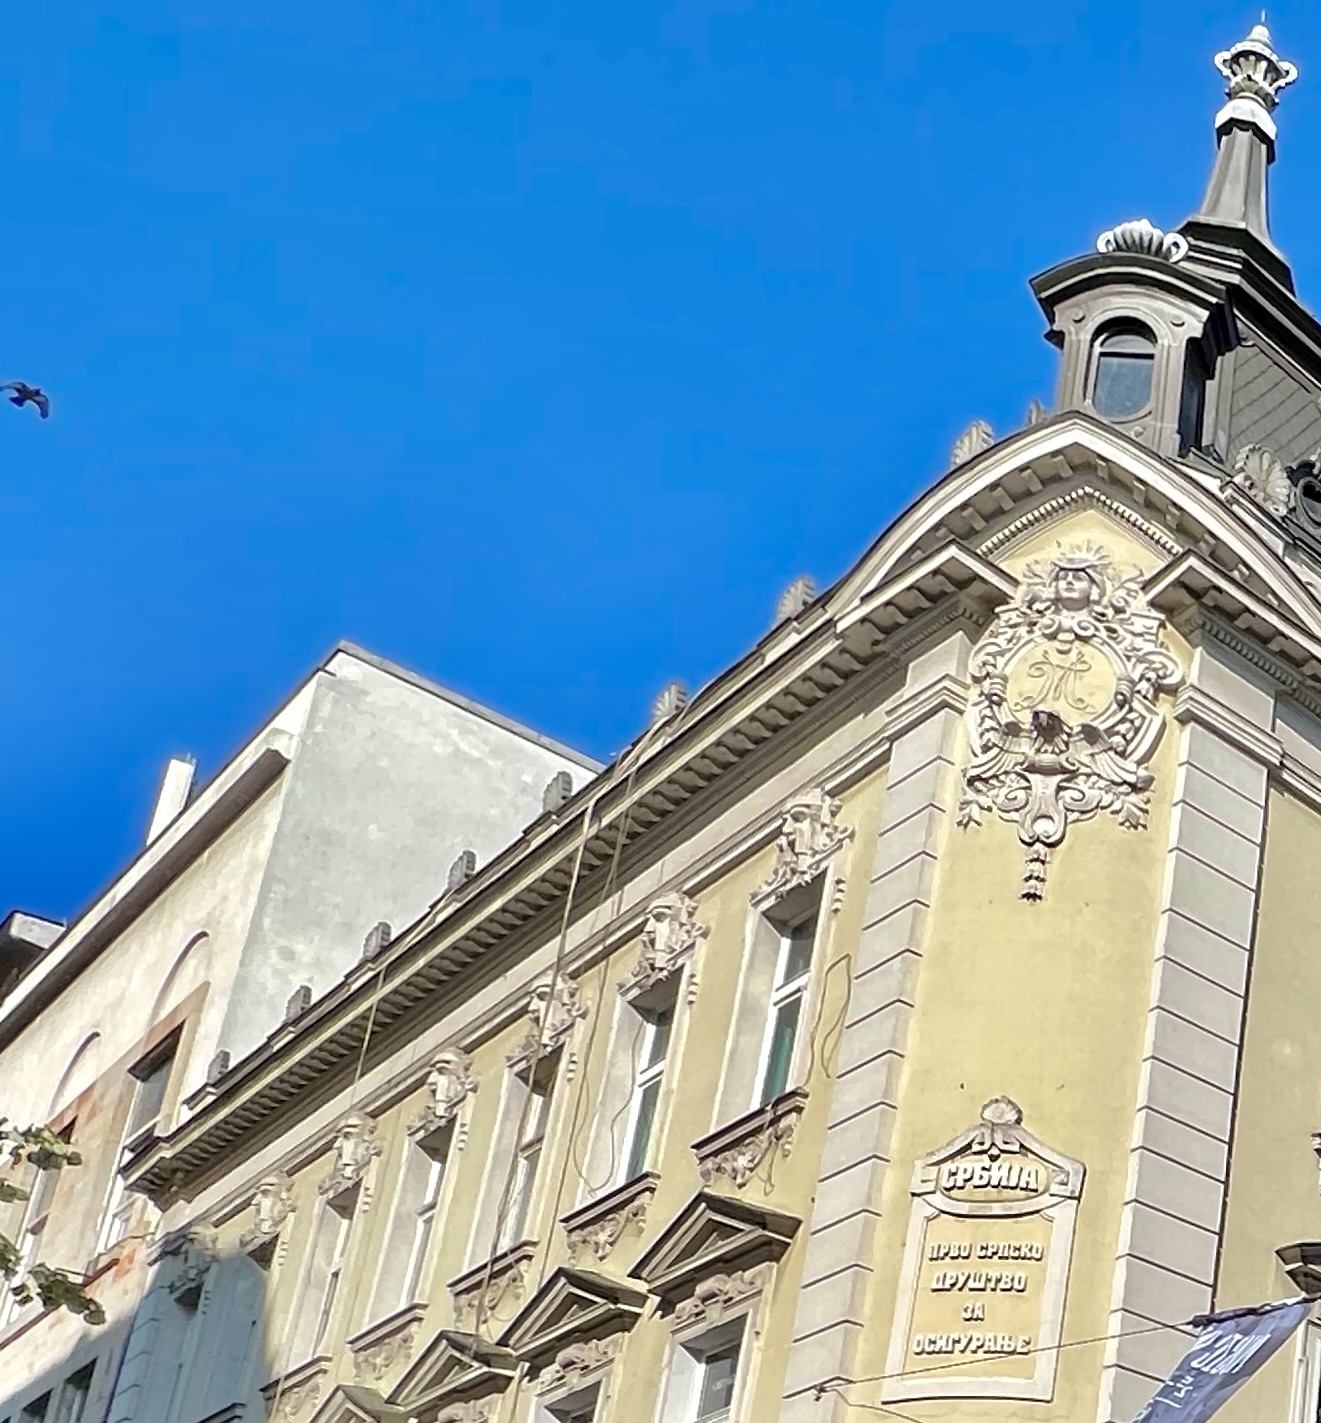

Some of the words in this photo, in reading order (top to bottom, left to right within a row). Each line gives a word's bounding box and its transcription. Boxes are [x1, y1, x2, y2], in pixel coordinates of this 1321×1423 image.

[928, 1242, 972, 1262] ПРВО
[976, 1243, 1044, 1263] СРПСКО
[930, 1272, 1027, 1293] ДРУШТВО
[962, 1301, 985, 1322] ЗА
[912, 1334, 1032, 1357] ОСИГУРАЊЕ
